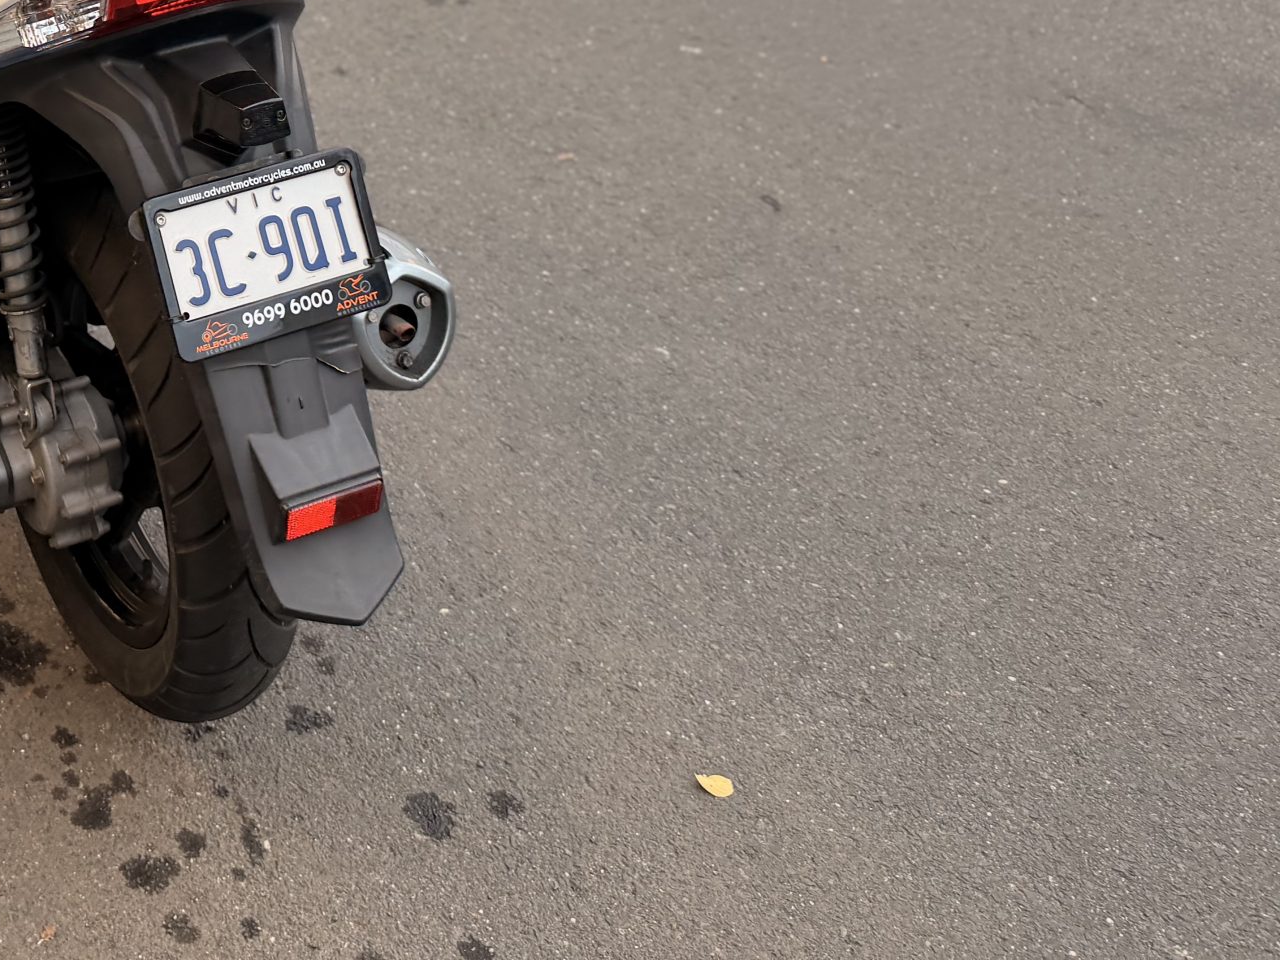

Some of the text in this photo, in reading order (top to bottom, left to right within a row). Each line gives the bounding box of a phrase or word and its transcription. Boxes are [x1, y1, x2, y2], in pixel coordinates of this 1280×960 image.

[178, 158, 326, 205] www.adventmotorcycles.com.au
[226, 186, 282, 214] VIC
[242, 289, 334, 328] 9699 6000
[336, 290, 378, 311] ADVENT
[196, 332, 249, 353] MELBOURNE
